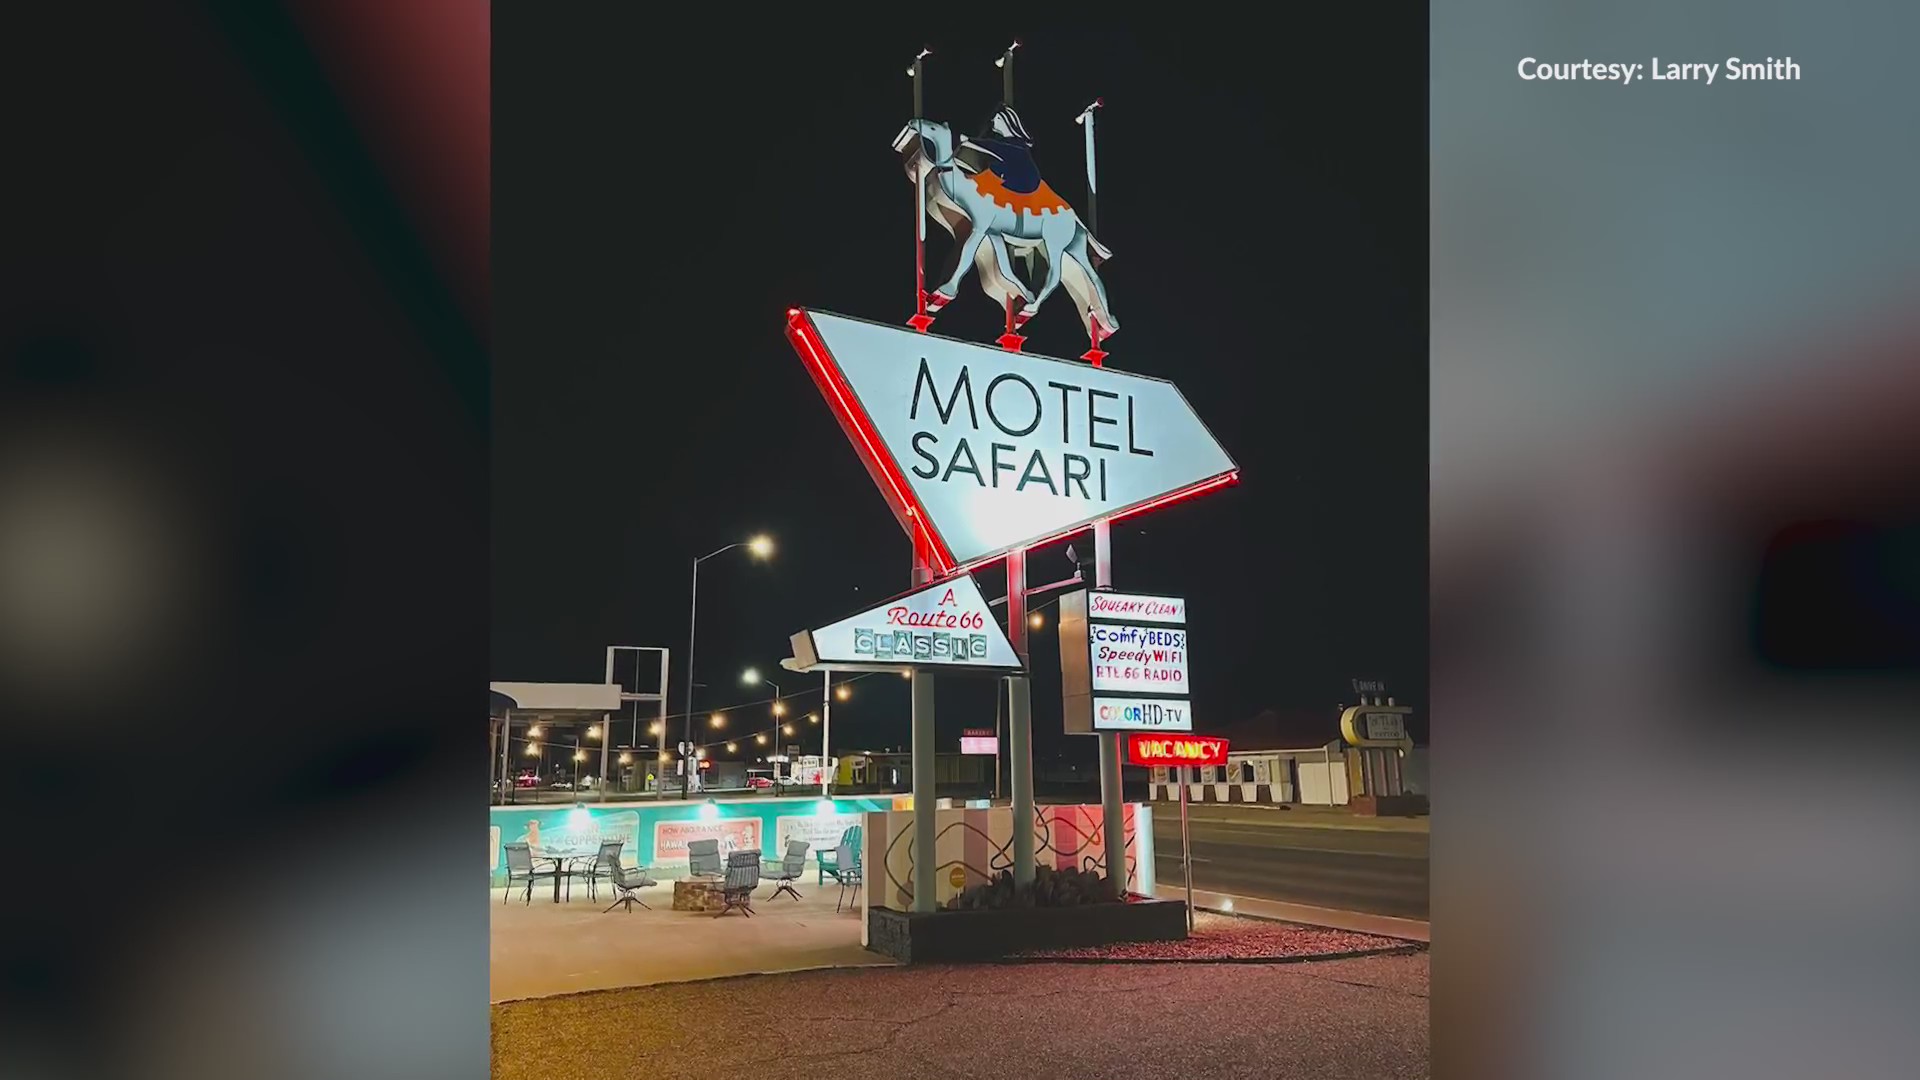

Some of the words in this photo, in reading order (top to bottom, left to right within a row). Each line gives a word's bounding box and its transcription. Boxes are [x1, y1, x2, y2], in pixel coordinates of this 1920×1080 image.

[909, 357, 1154, 457] MOTEL
[911, 431, 1107, 502] SAFARI
[938, 588, 957, 606] A
[1091, 595, 1144, 612] SQUEAKY
[887, 606, 957, 629] Route
[960, 610, 984, 630] 66
[855, 629, 987, 660] CLASSIC
[1149, 631, 1181, 648] BEDS
[1098, 646, 1152, 665] Speedy
[1124, 667, 1140, 679] 66
[1144, 668, 1182, 681] RADIO
[1137, 739, 1221, 760] VACANCY
